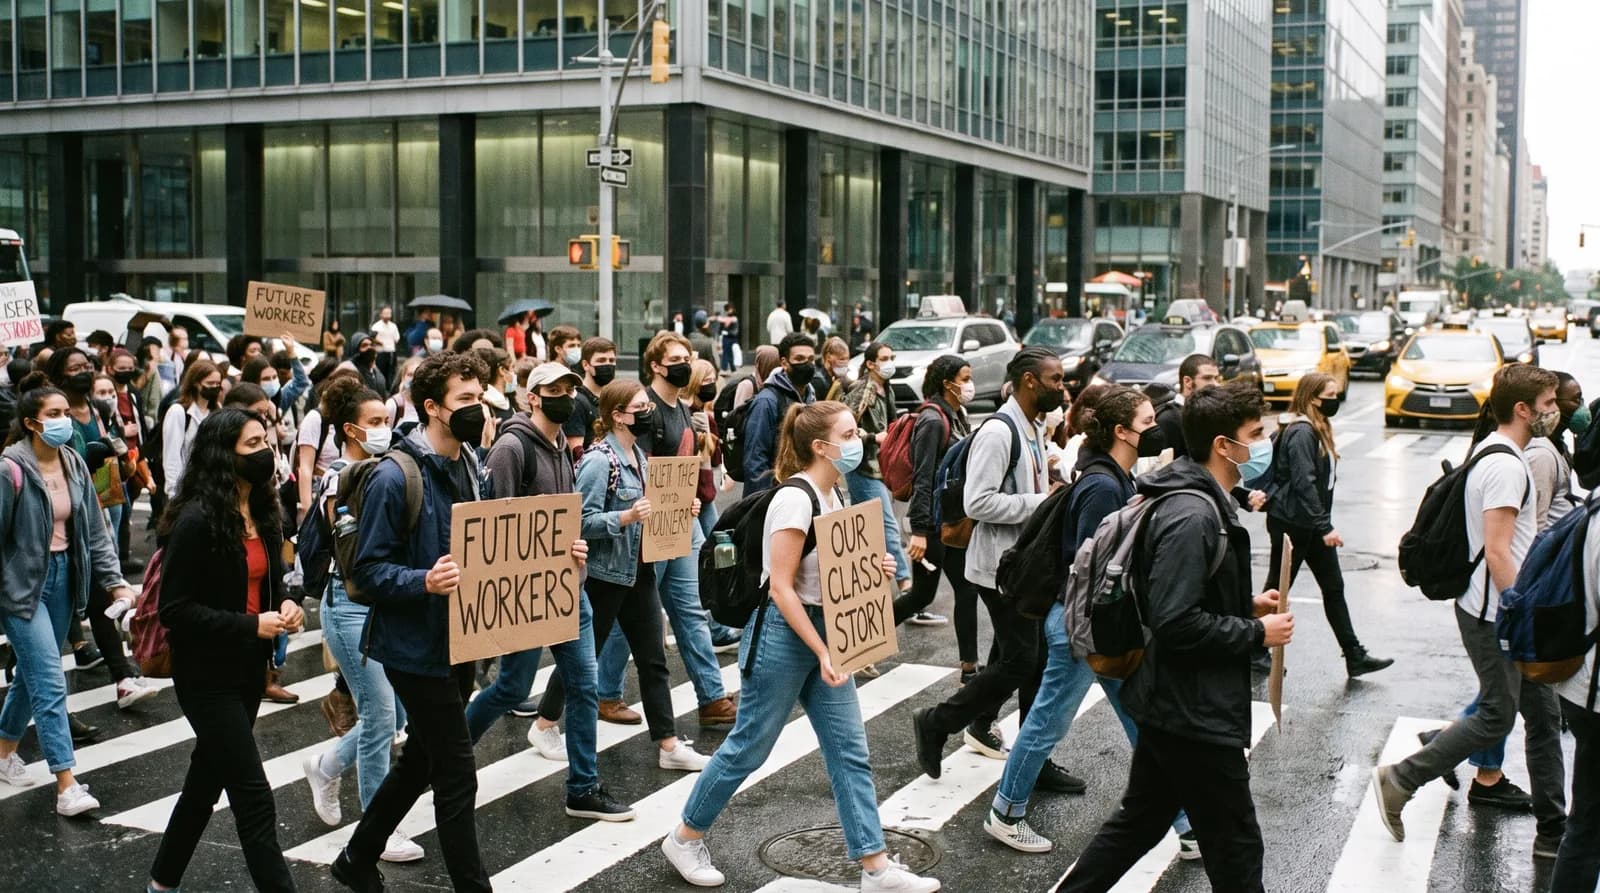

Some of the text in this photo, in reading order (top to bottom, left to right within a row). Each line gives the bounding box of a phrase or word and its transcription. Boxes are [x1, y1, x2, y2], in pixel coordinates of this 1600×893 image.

[253, 304, 316, 327] WORKERS
[256, 287, 312, 309] FUTURE
[463, 508, 568, 568] FUTURE
[831, 513, 869, 558] OUR
[457, 568, 574, 635] WORKERS
[828, 552, 882, 604] CLASS
[835, 595, 886, 653] STORY
